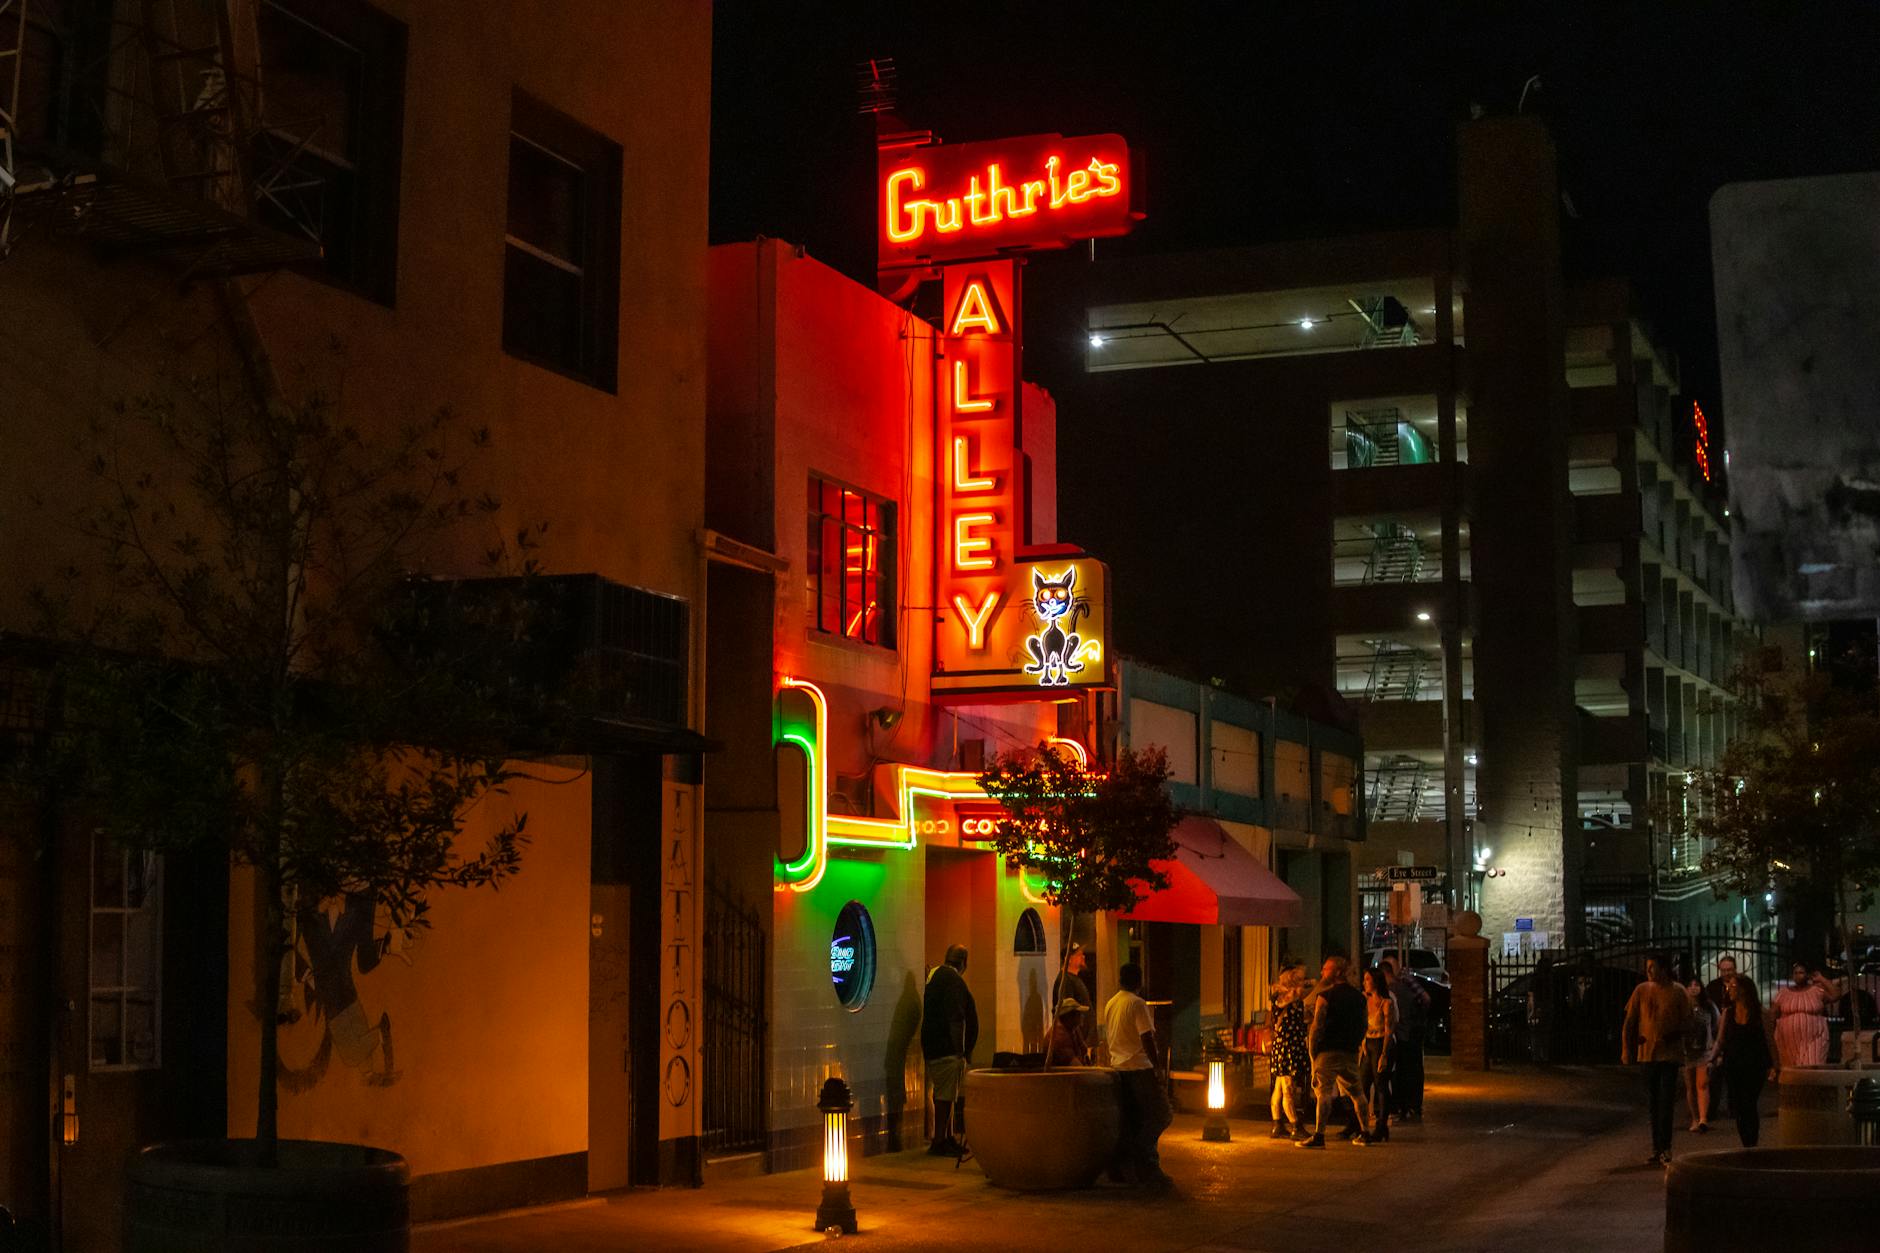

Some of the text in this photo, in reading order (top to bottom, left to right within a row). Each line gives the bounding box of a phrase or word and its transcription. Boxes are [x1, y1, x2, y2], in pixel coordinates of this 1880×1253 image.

[886, 156, 1121, 242] Guthrie's
[952, 275, 1000, 650] ALLEY
[664, 789, 692, 1107] TATTOO
[1410, 867, 1433, 877] Street
